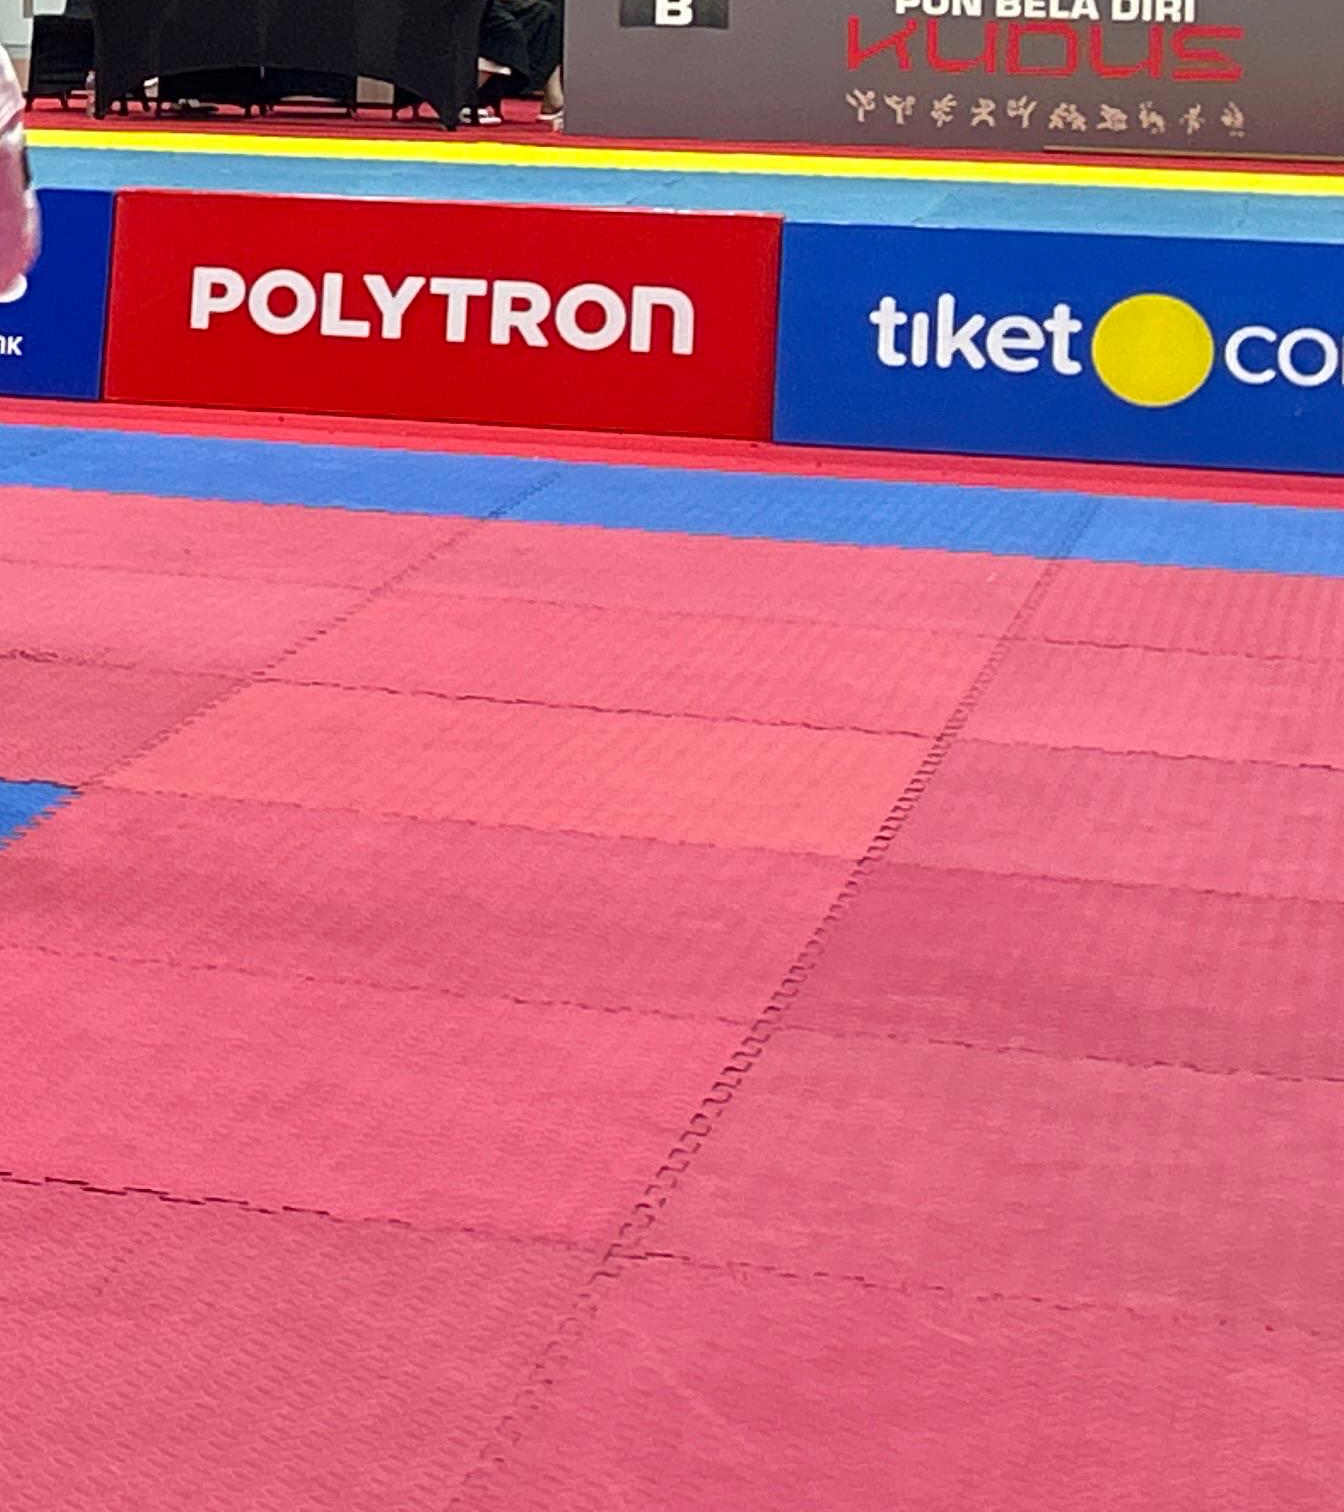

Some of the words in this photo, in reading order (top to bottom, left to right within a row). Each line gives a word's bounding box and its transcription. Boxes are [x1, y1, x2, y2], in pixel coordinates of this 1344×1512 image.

[847, 14, 1244, 83] KUDUS
[189, 265, 696, 356] POLYTRON
[868, 292, 1083, 376] tiket
[1224, 325, 1344, 387] co
